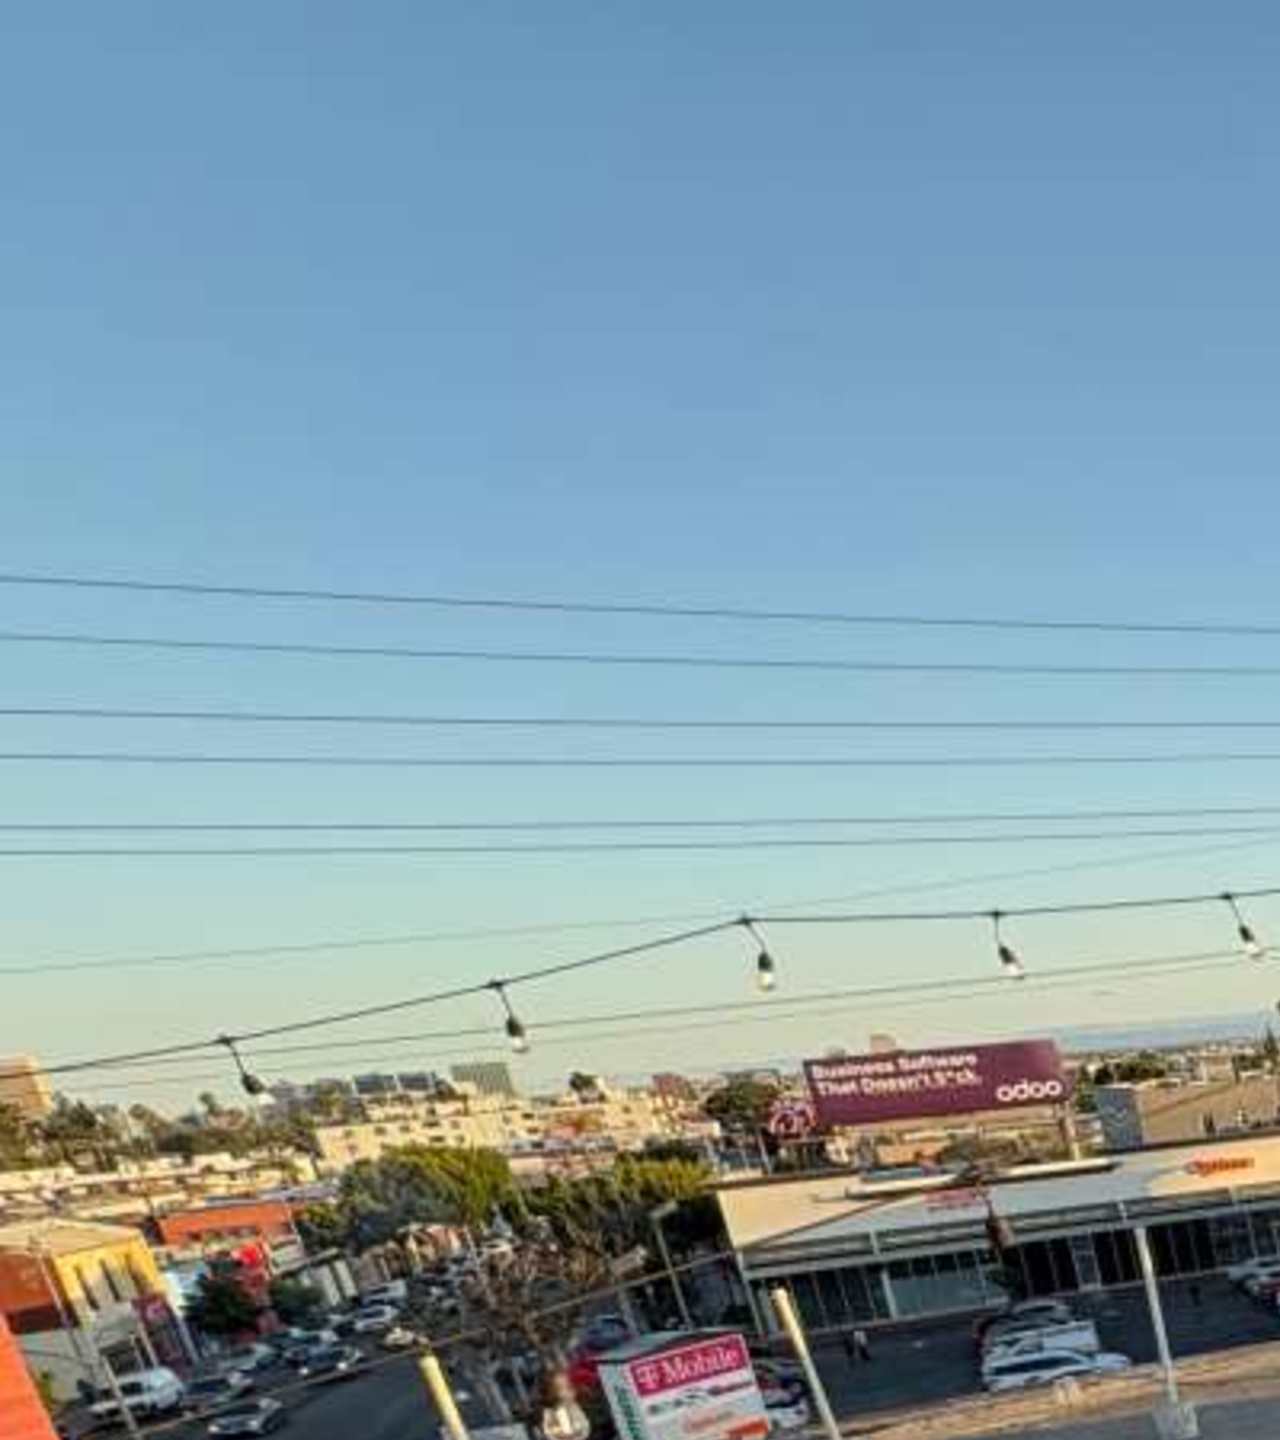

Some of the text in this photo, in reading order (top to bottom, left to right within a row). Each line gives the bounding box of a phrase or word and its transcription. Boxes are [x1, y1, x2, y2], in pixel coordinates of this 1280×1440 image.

[812, 1053, 978, 1079] Business Software
[816, 1077, 859, 1096] That
[996, 1080, 1063, 1102] odoo
